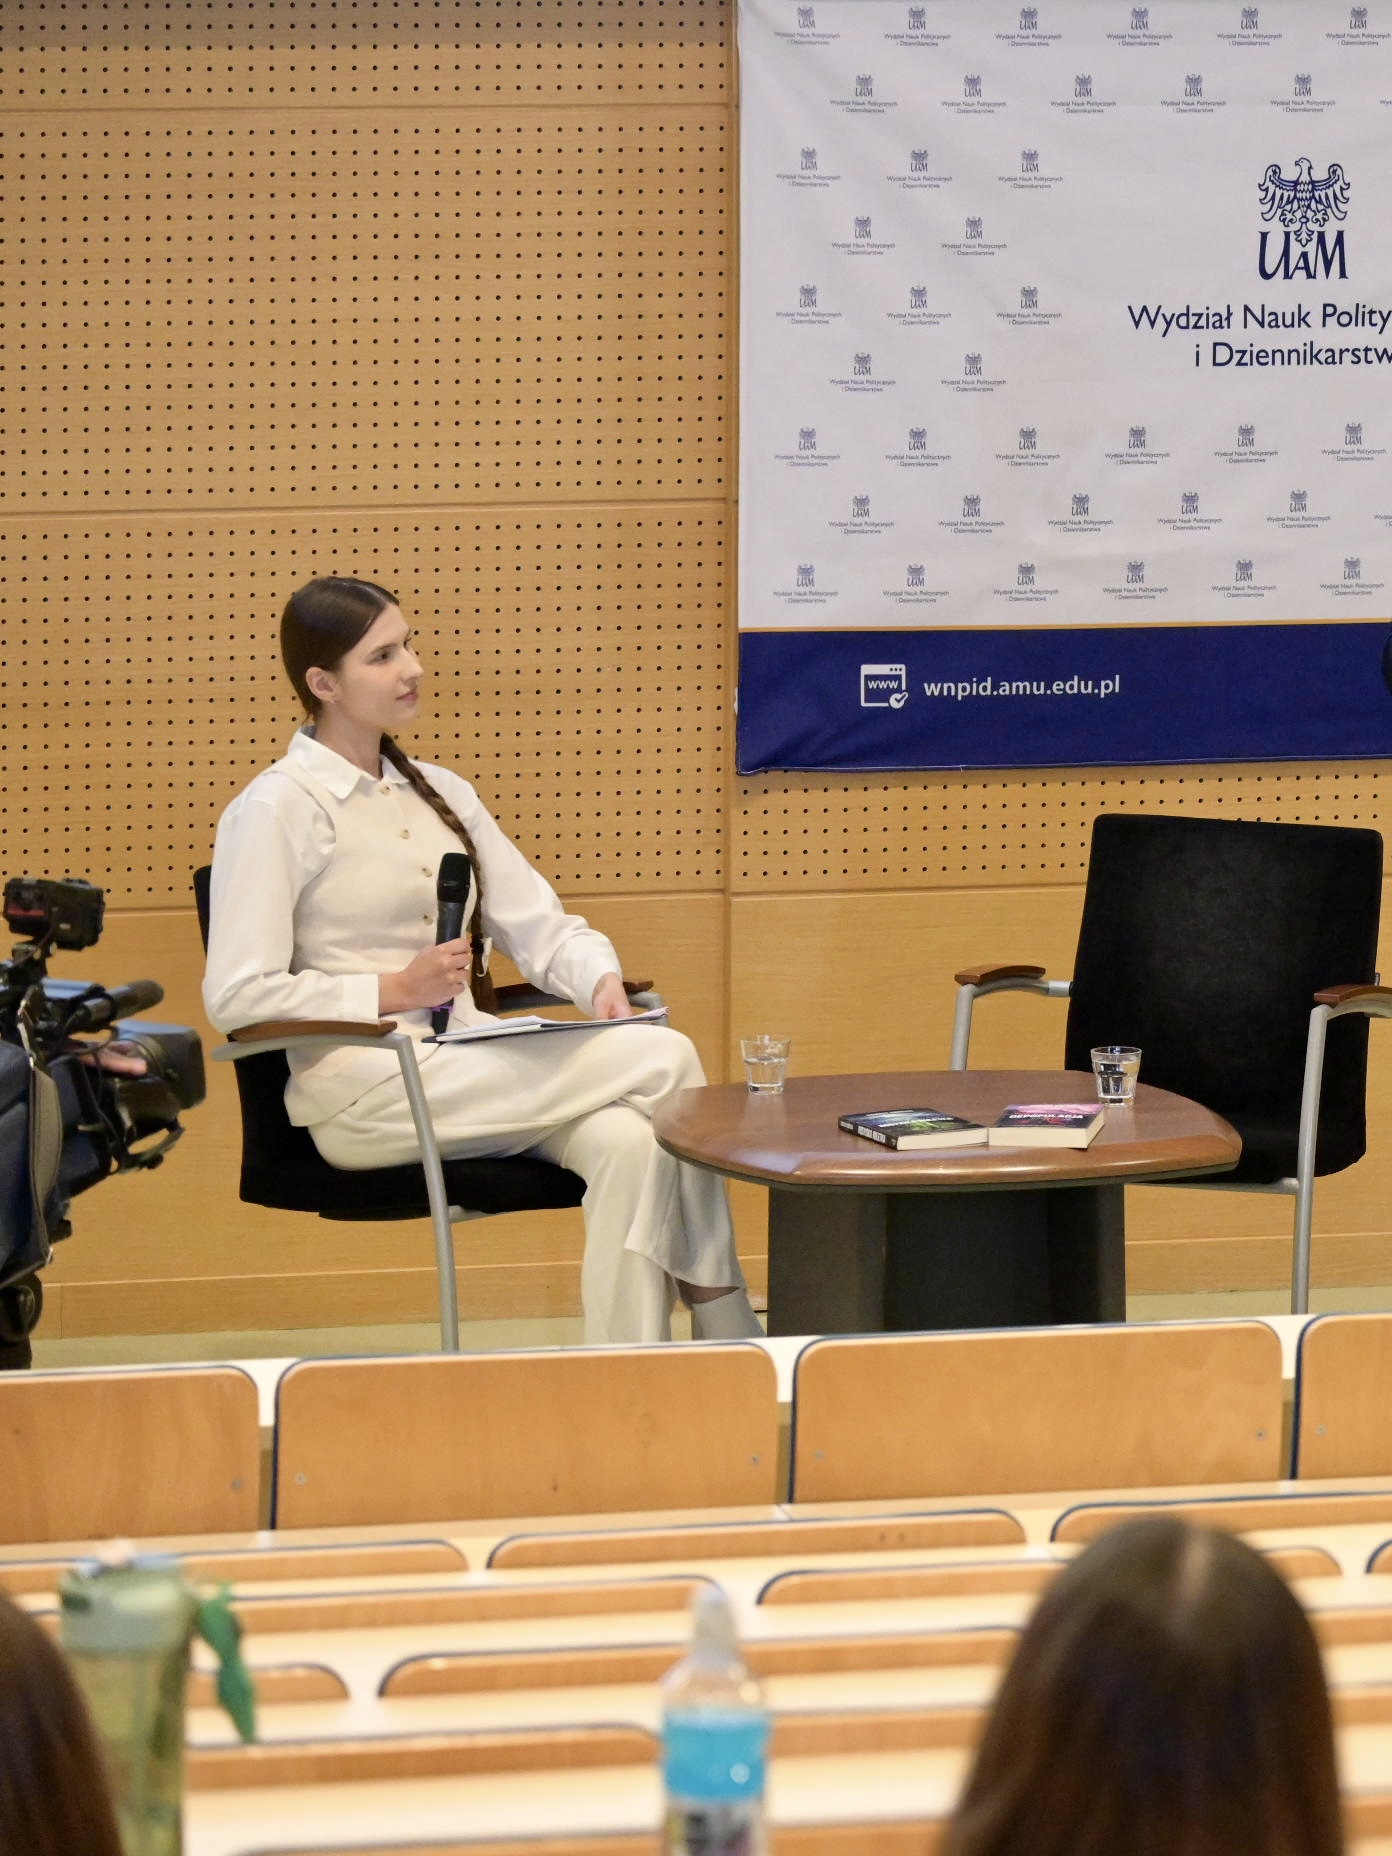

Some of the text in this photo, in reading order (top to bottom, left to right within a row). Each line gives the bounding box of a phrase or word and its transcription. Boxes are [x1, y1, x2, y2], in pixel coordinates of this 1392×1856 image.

[1258, 230, 1349, 280] UAM
[1127, 304, 1233, 337] Wydział
[1243, 304, 1312, 328] Nauk
[1195, 343, 1201, 367] i
[867, 679, 899, 689] www
[923, 675, 1120, 701] wnpid.amu.edu.pl
